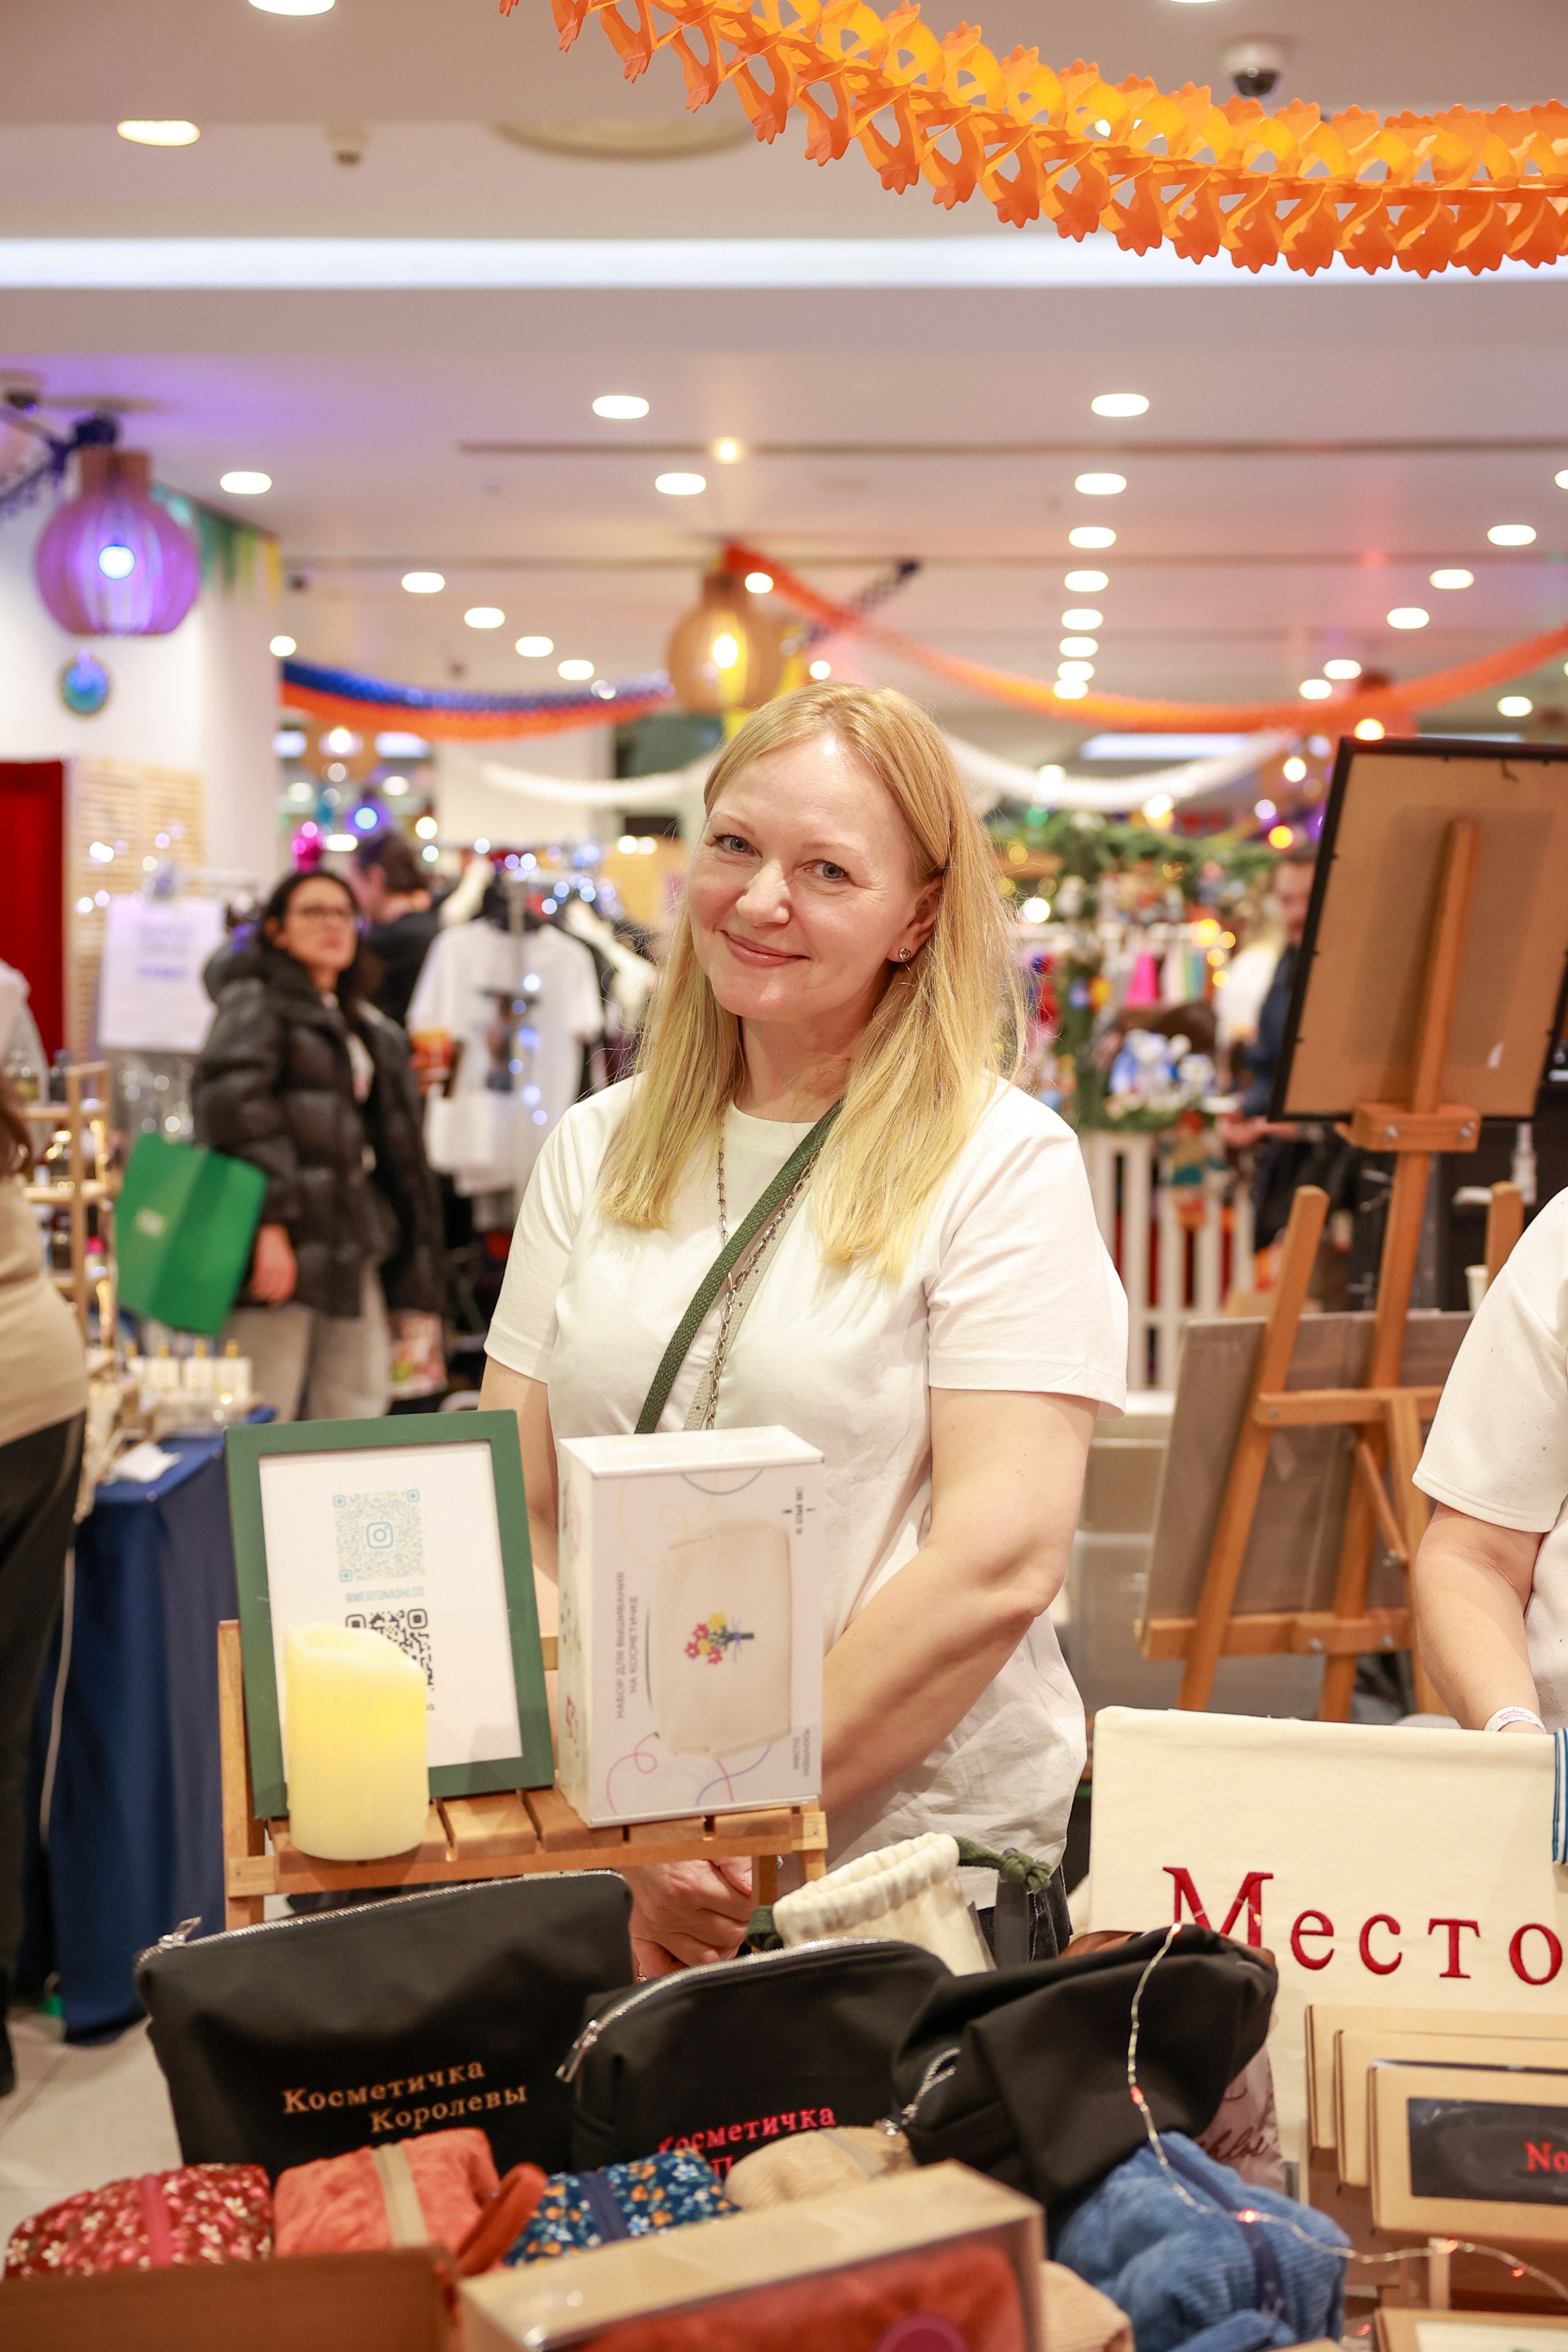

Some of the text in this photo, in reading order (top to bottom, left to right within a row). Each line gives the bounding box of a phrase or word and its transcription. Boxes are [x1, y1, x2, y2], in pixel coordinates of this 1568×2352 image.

[615, 1572, 625, 1719] НАБОР ДЛЯ ВЫШИВАНИЯ
[629, 1597, 638, 1694] НА КОСМЕТИЧКЕ
[1162, 1866, 1564, 1986] Место
[282, 2061, 486, 2114] Косметичка
[369, 2085, 527, 2133] Королевы
